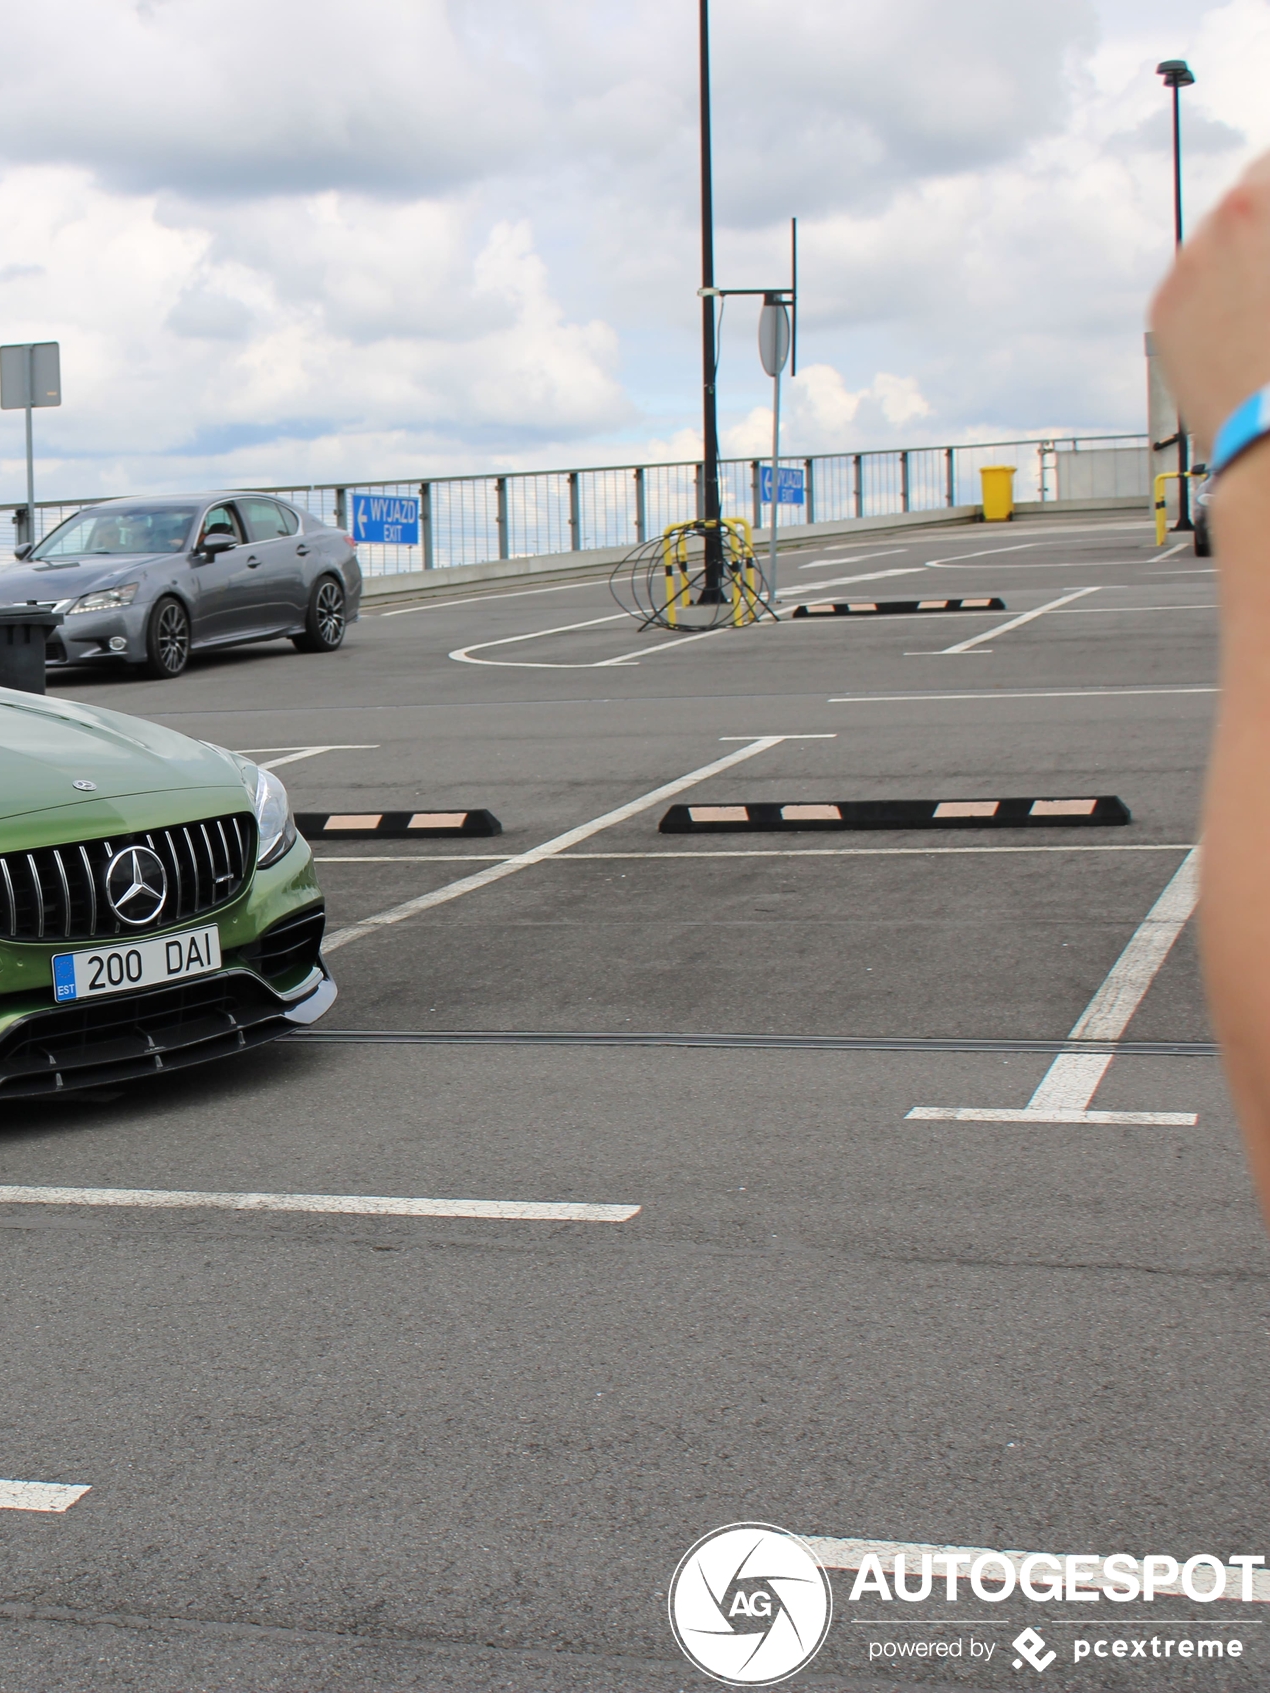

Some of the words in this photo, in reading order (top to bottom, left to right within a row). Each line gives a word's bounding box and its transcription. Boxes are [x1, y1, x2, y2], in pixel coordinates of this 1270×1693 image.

[370, 498, 416, 523] WYJAZD
[383, 524, 402, 542] EXIT
[87, 949, 142, 990] 200
[165, 933, 211, 975] DAI
[57, 984, 75, 996] EST
